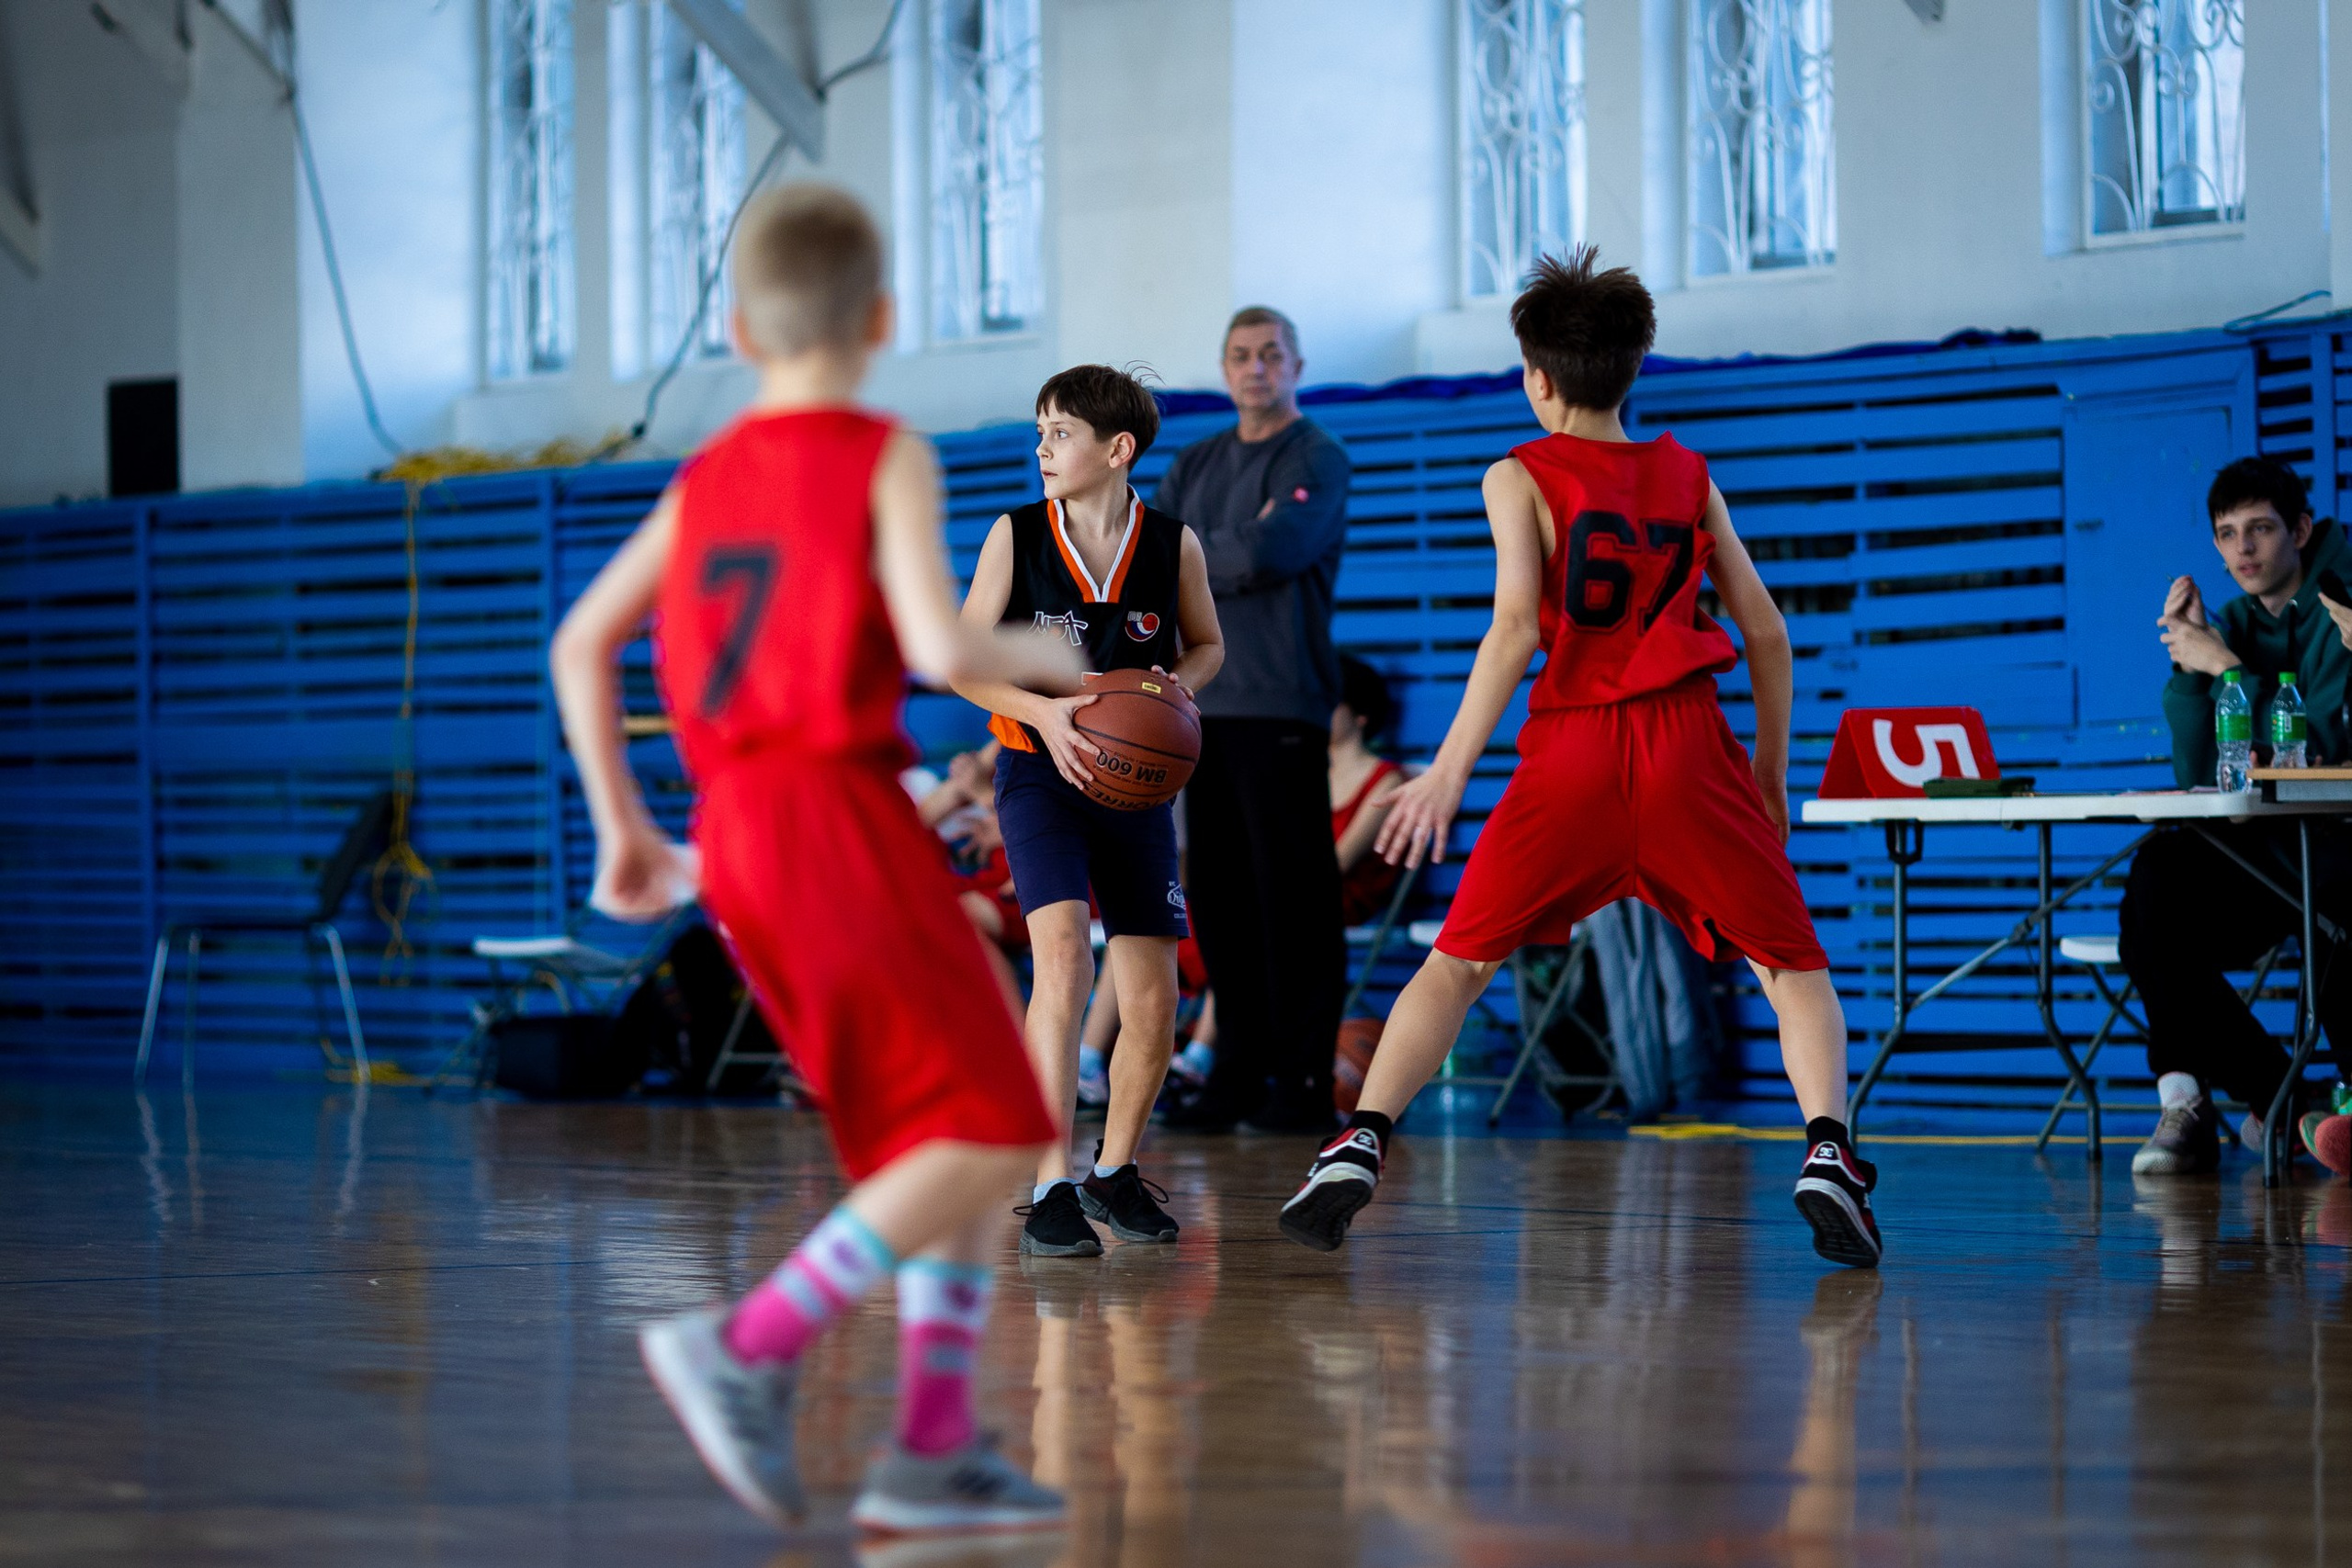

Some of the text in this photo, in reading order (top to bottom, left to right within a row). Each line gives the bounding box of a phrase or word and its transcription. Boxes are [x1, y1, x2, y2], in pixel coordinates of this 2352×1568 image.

[1564, 511, 1695, 637] 67
[700, 542, 780, 716] 7
[1096, 751, 1133, 776] 600
[1136, 765, 1168, 784] BM
[1872, 717, 1981, 788] 5
